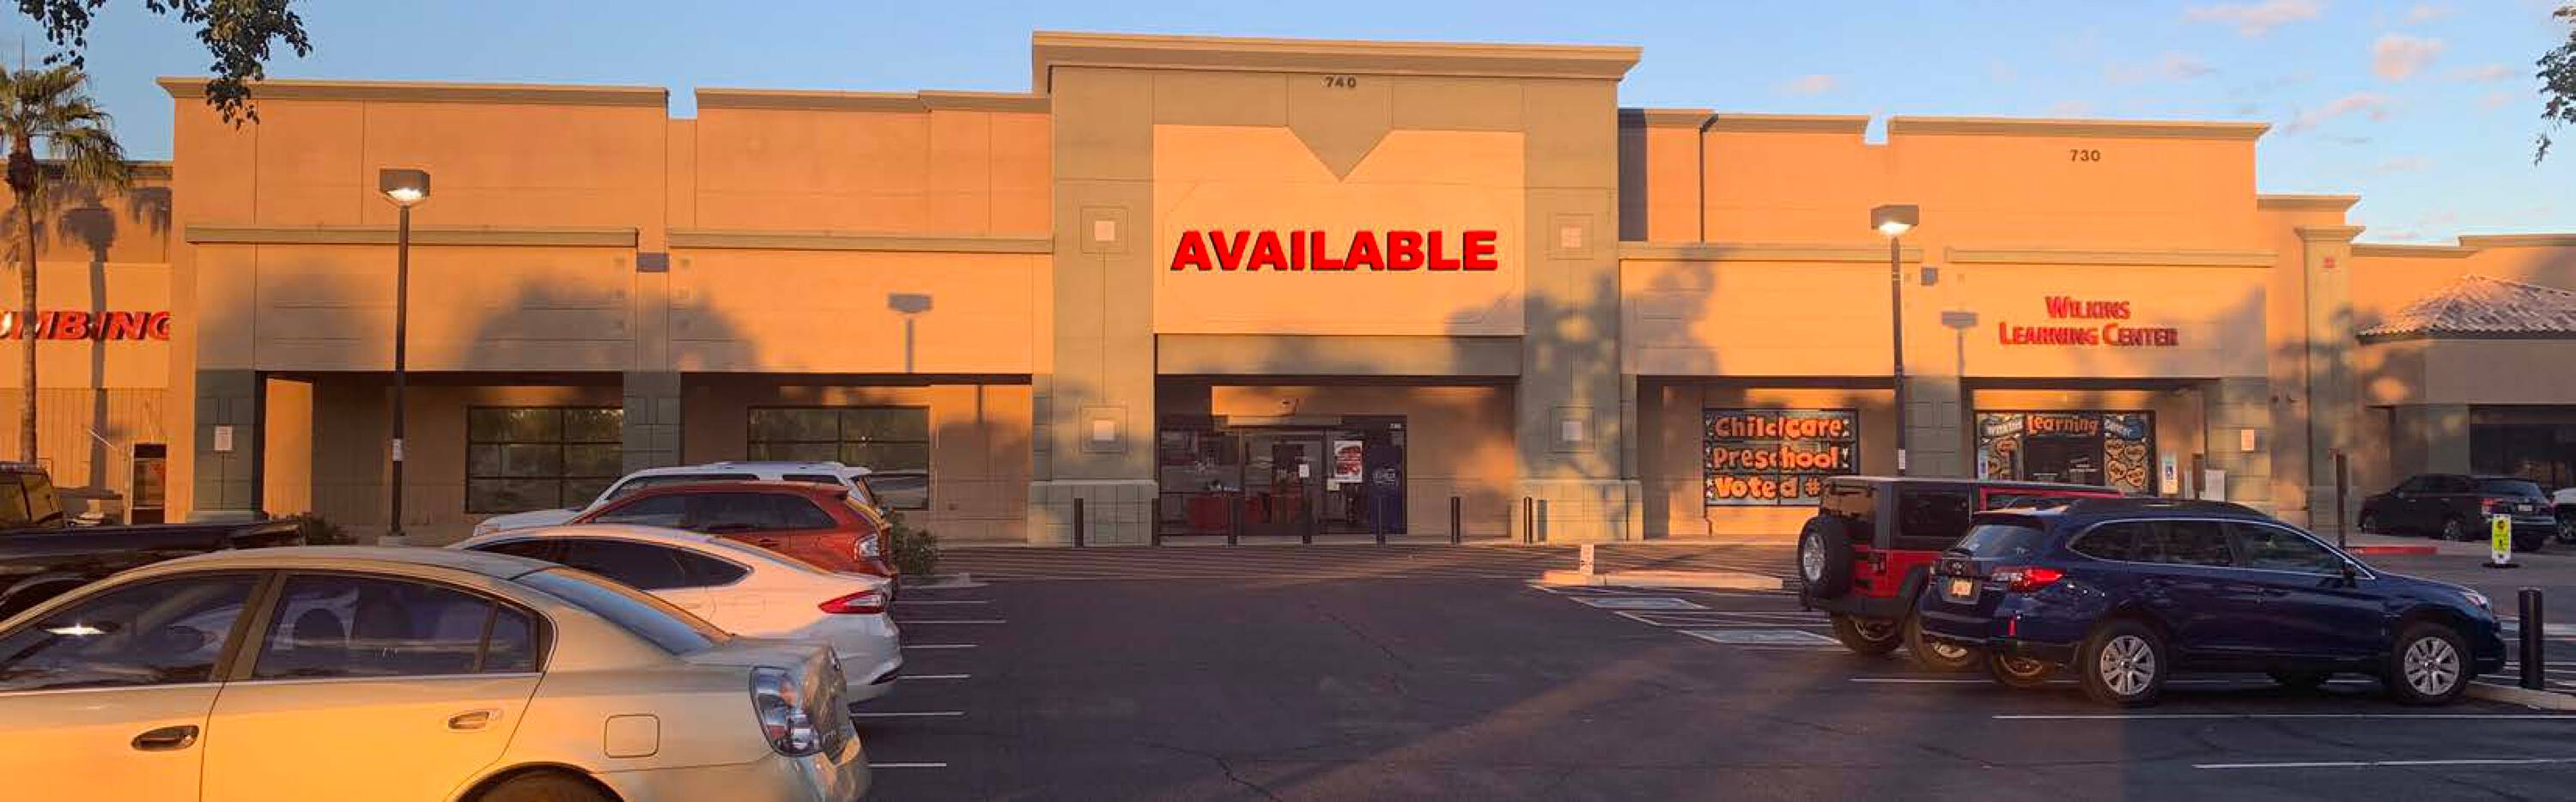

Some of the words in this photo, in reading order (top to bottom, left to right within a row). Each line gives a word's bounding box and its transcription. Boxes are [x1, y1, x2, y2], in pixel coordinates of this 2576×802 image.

[1325, 75, 1357, 88] 740
[2069, 149, 2100, 162] 730
[1712, 446, 1839, 470] Preschool
[1715, 474, 1799, 499] Voted
